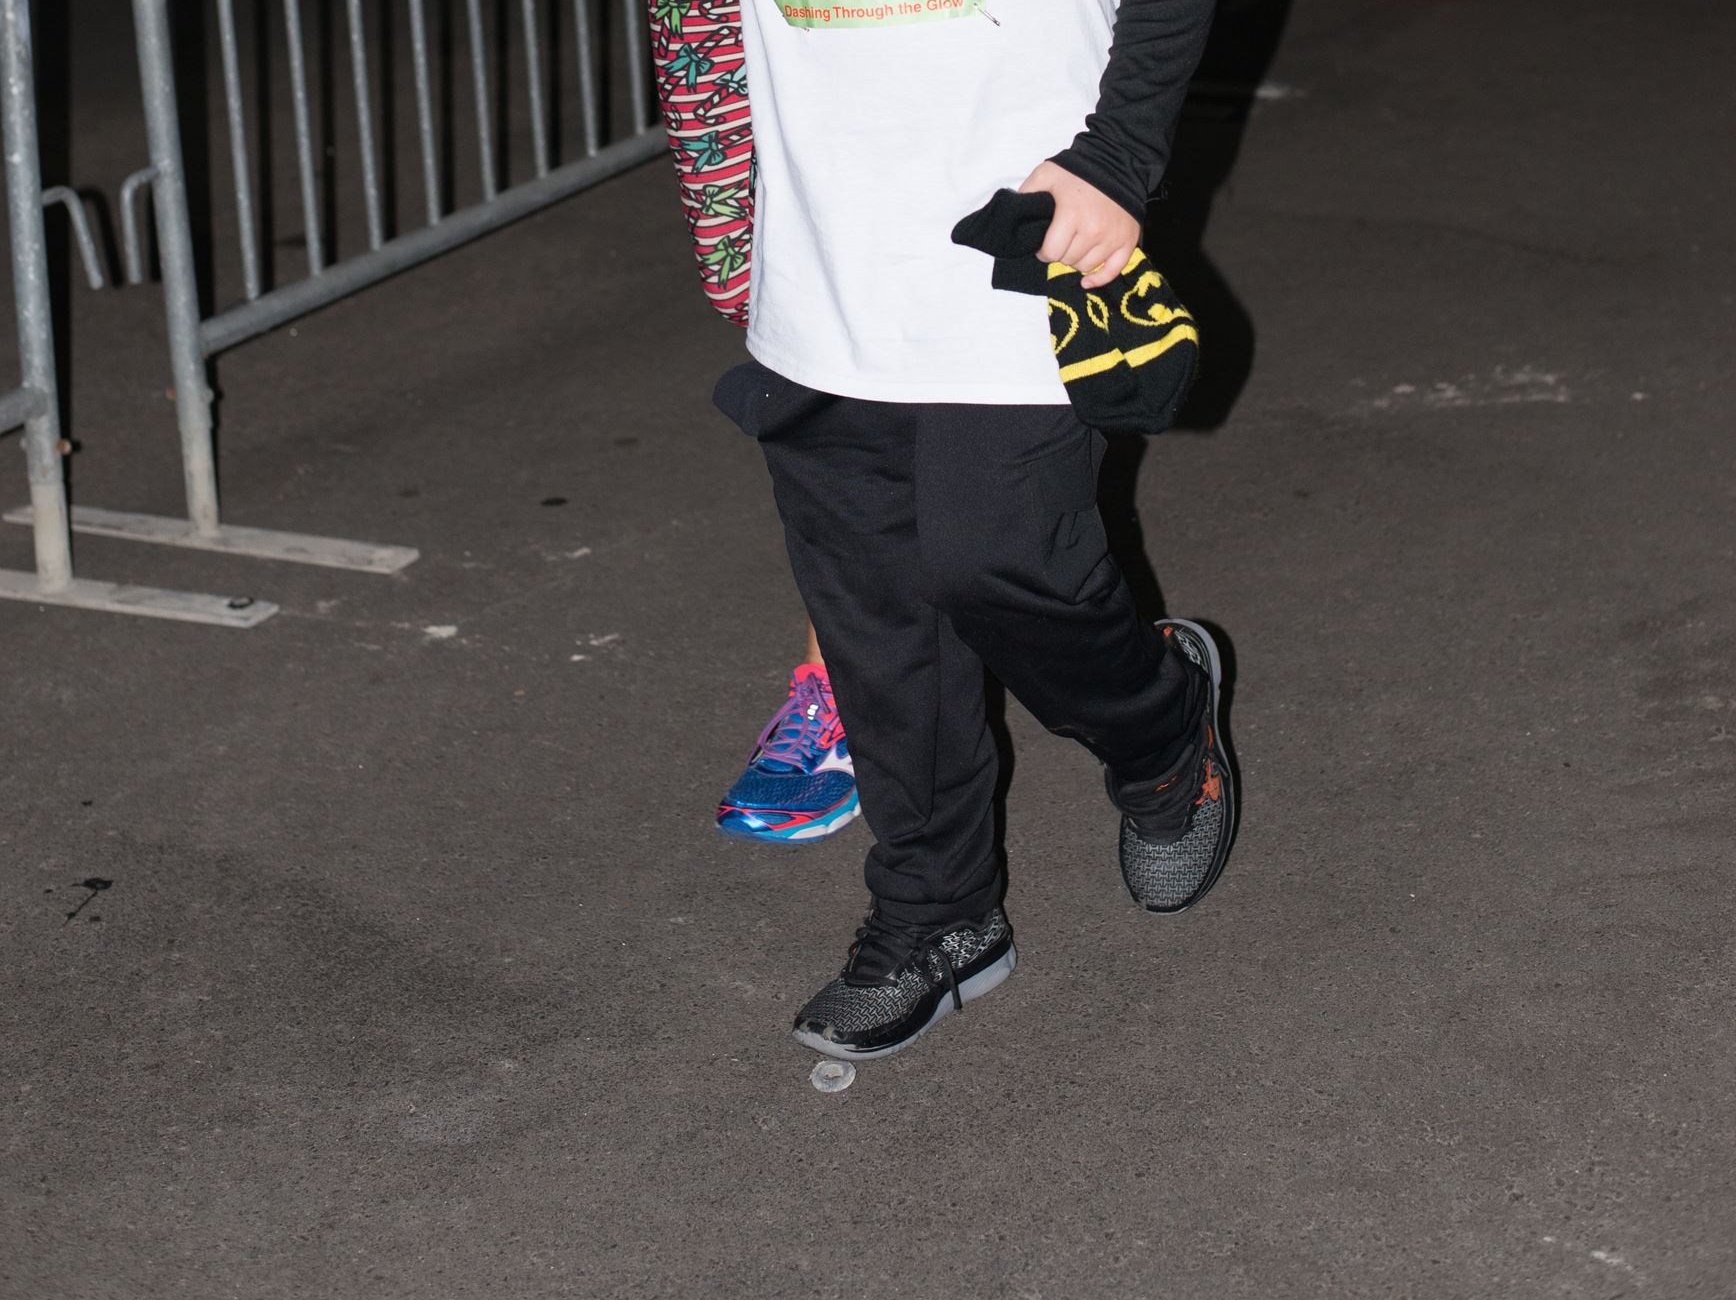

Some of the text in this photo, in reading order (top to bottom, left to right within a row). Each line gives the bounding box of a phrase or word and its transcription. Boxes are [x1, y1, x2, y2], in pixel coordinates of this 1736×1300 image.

[784, 5, 831, 22] Dashing
[833, 3, 893, 19] Through
[898, 1, 922, 14] the
